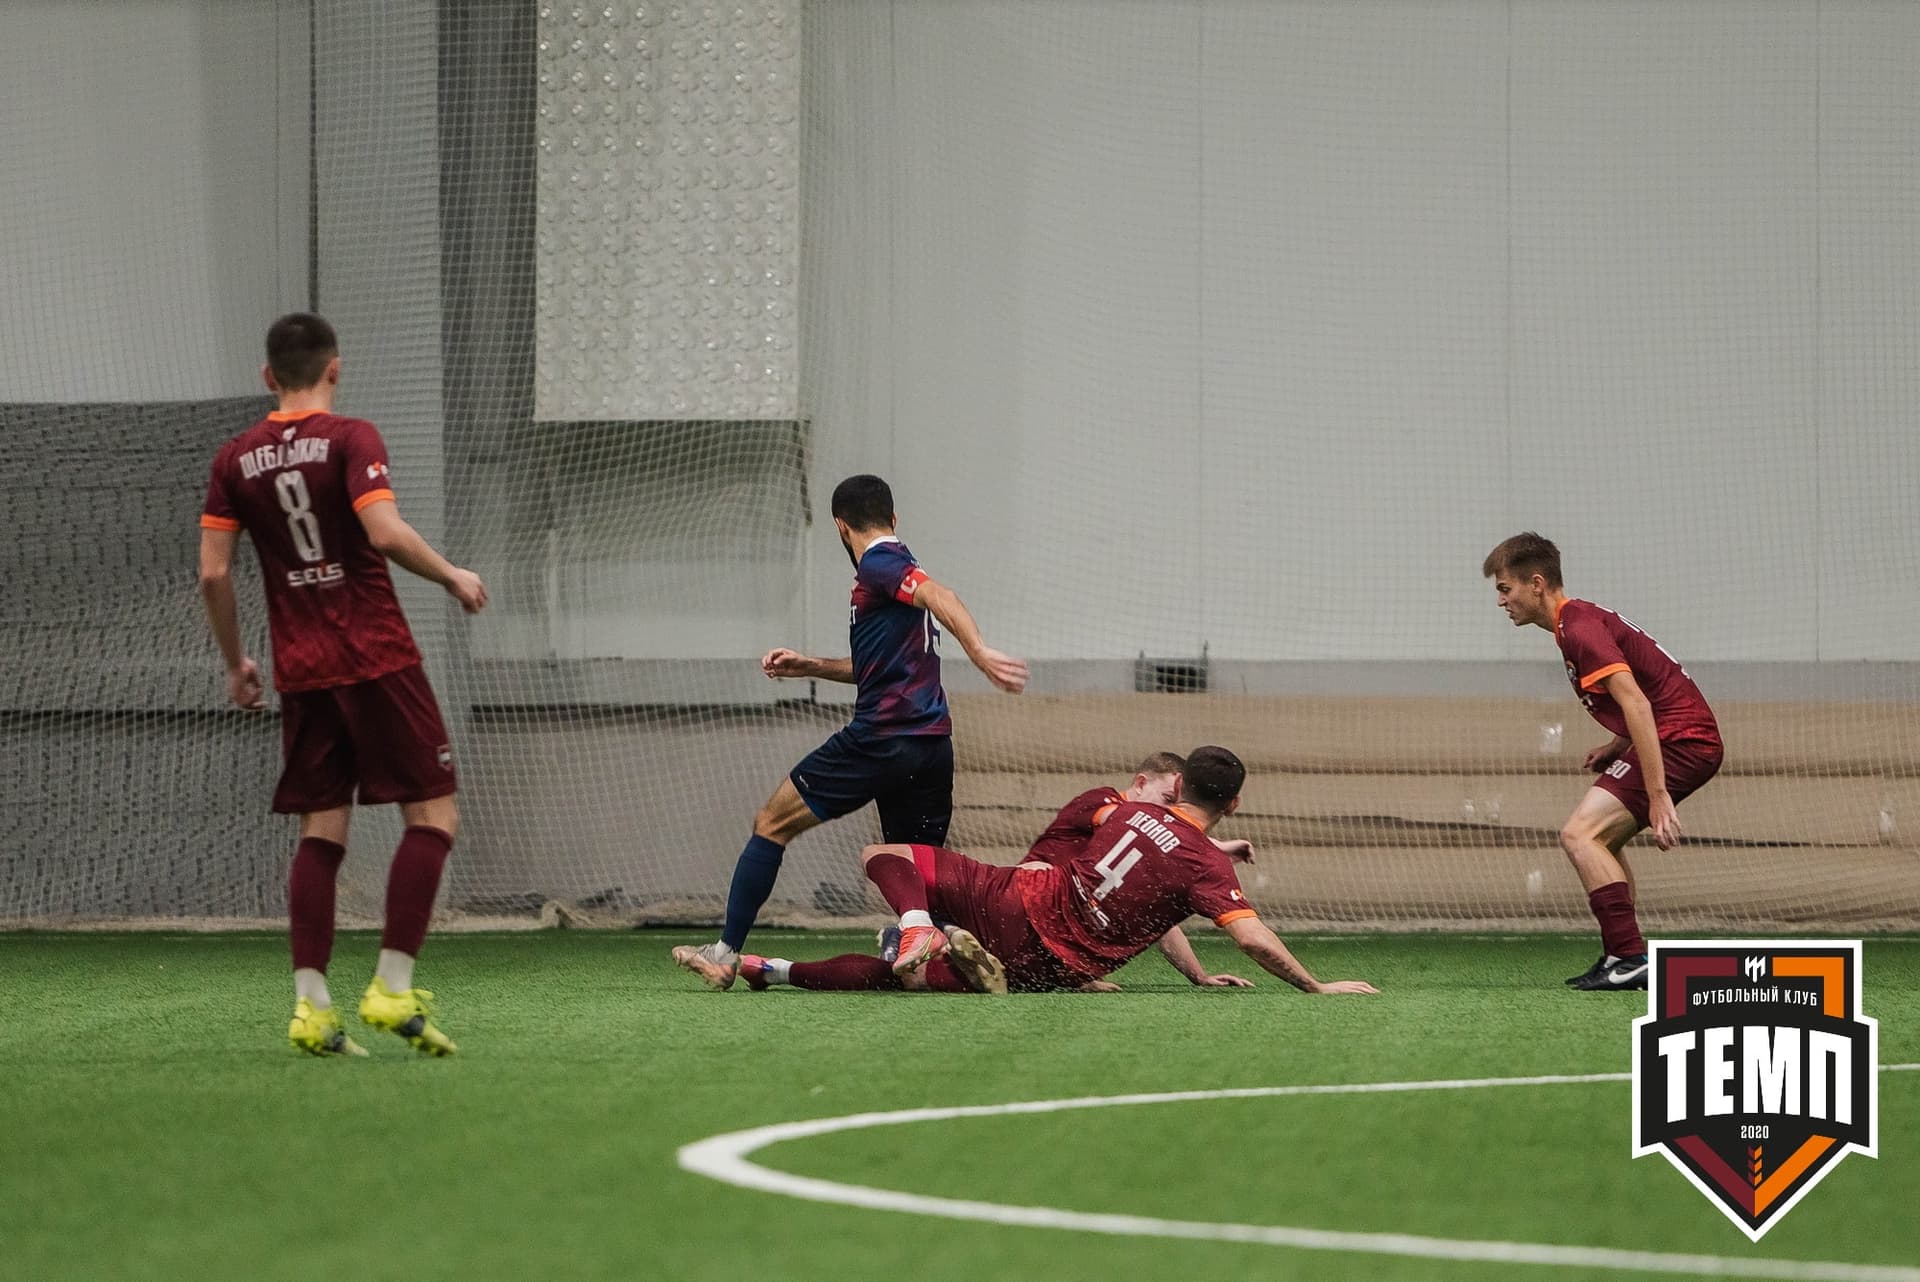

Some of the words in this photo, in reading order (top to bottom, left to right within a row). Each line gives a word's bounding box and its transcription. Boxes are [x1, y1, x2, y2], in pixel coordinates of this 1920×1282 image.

[275, 470, 324, 562] 8
[1605, 760, 1632, 779] 30
[1125, 810, 1181, 854] ЛЕОНОВ
[1093, 829, 1144, 901] 4
